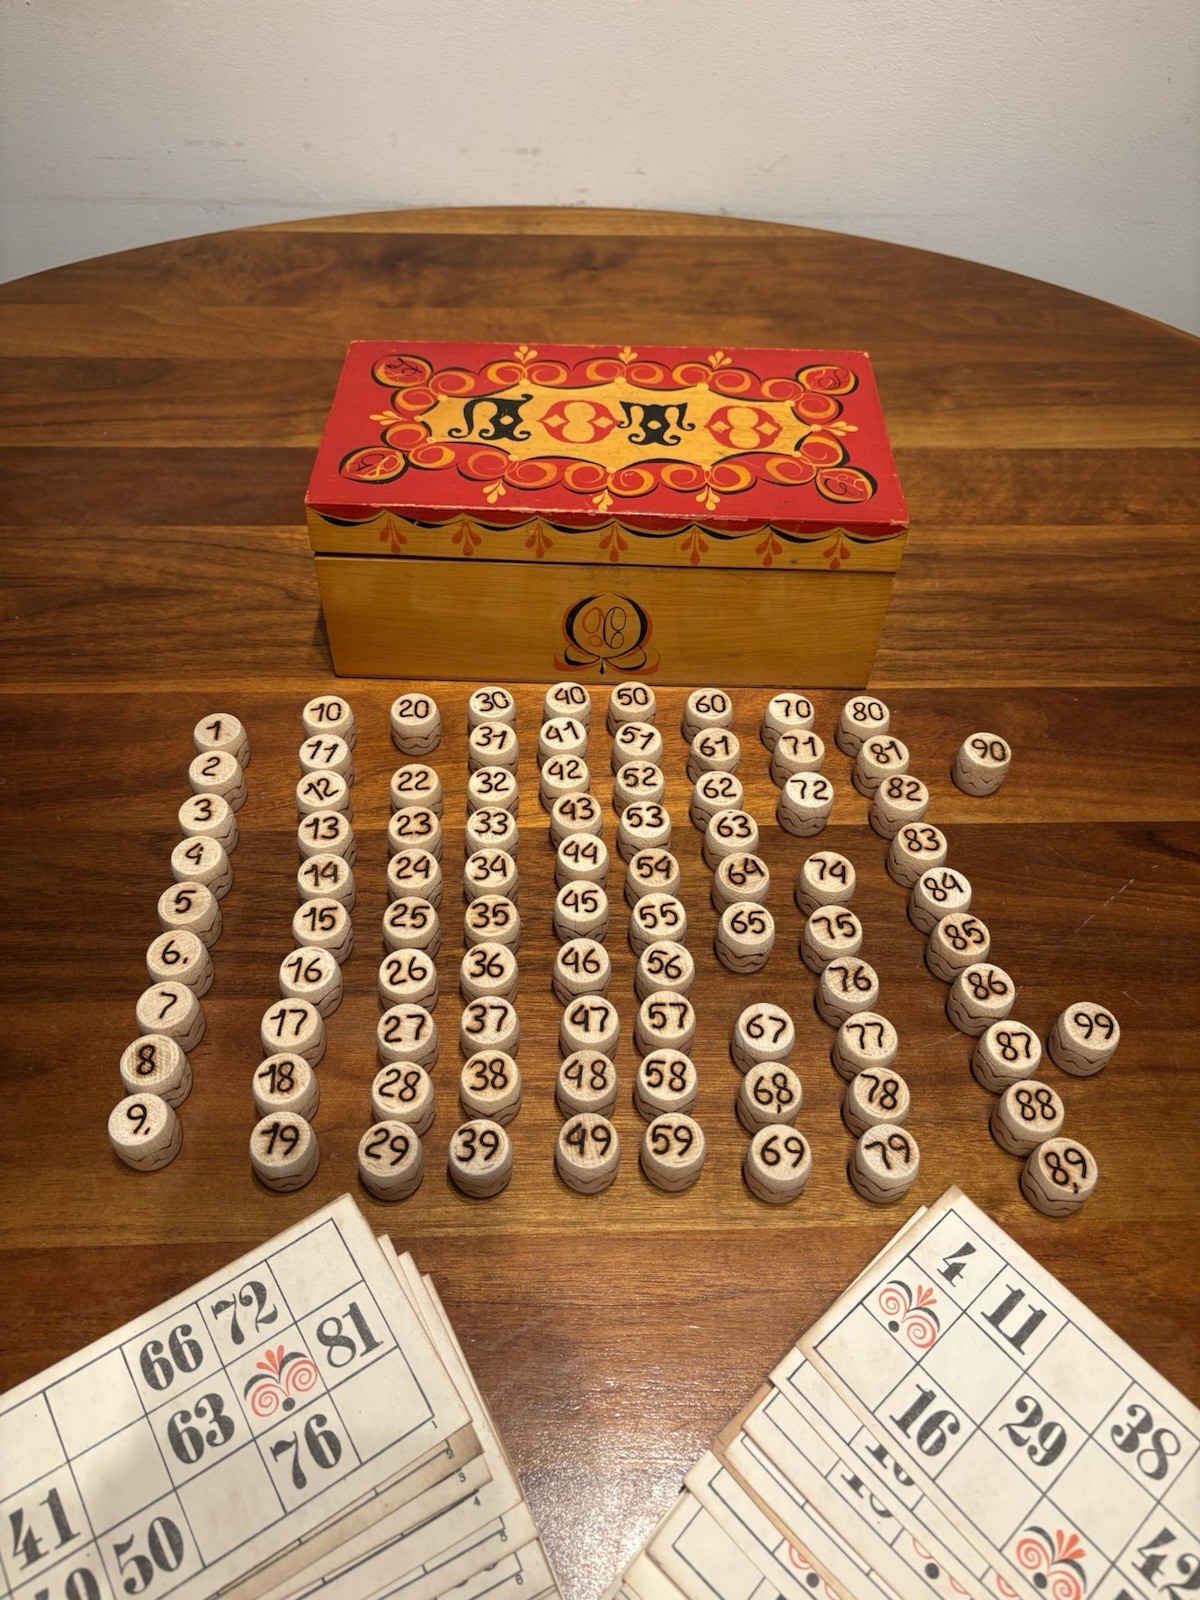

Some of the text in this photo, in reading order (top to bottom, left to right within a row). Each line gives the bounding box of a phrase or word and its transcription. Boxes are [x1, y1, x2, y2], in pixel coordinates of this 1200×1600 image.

[476, 691, 510, 712] 30
[554, 686, 586, 704] 40
[617, 687, 650, 705] 50
[696, 695, 726, 713] 60
[310, 702, 342, 722] 10
[399, 700, 429, 718] 20
[775, 700, 811, 718] 70
[853, 702, 884, 721] 80
[206, 721, 222, 740] 1
[475, 726, 508, 750] 31
[545, 721, 579, 742] 41
[620, 726, 654, 750] 51
[307, 740, 339, 763] 11
[699, 735, 729, 757] 61
[782, 736, 817, 756] 71
[870, 741, 902, 764] 81
[971, 739, 1008, 762] 90
[202, 757, 221, 776] 2
[548, 760, 582, 780] 42
[623, 767, 657, 787] 52
[303, 778, 339, 801] 12
[398, 771, 430, 791] 22
[476, 772, 509, 793] 32
[703, 777, 737, 798] 62
[790, 780, 829, 801] 72
[887, 777, 921, 801] 82
[194, 798, 213, 821] 3
[559, 797, 594, 821] 43
[627, 806, 664, 828] 53
[305, 816, 339, 840] 13
[397, 812, 432, 836] 23
[475, 811, 508, 835] 33
[716, 815, 752, 838] 63
[563, 841, 597, 864] 44
[904, 828, 940, 852] 83
[185, 843, 204, 865] 4
[304, 861, 339, 887] 14
[396, 856, 430, 880] 24
[471, 855, 507, 881] 34
[637, 856, 672, 880] 54
[727, 858, 765, 887] 64
[809, 858, 847, 885] 74
[923, 872, 964, 902] 84
[173, 889, 197, 914] 5
[562, 890, 598, 913] 45
[303, 906, 338, 931] 15
[390, 903, 431, 930] 25
[472, 902, 509, 928] 35
[639, 902, 679, 929] 55
[731, 911, 766, 934] 65
[812, 913, 857, 939] 75
[944, 919, 985, 951] 85
[287, 957, 322, 983] 16
[386, 956, 427, 986] 26
[469, 949, 504, 979] 36
[561, 947, 600, 974] 46
[647, 950, 682, 980] 56
[828, 965, 872, 992] 76
[966, 970, 1008, 1001] 86
[158, 992, 180, 1020] 7
[466, 1004, 508, 1034] 37
[570, 1004, 609, 1032] 47
[648, 1002, 688, 1030] 57
[270, 1009, 308, 1037] 17
[384, 1014, 426, 1043] 27
[746, 1014, 787, 1043] 67
[846, 1022, 884, 1050] 77
[996, 1031, 1031, 1061] 87
[136, 1043, 157, 1077] 8
[258, 1061, 297, 1095] 18
[379, 1069, 421, 1102] 28
[470, 1058, 508, 1091] 38
[564, 1059, 608, 1091] 48
[645, 1060, 686, 1092] 58
[860, 1073, 899, 1111] 78
[1014, 1089, 1057, 1121] 88
[261, 1122, 300, 1156] 19
[365, 1128, 410, 1166] 29
[456, 1127, 499, 1163] 39
[564, 1122, 611, 1157] 49
[651, 1124, 694, 1157] 59
[760, 1135, 805, 1168] 69
[864, 1133, 911, 1170] 79
[937, 1242, 978, 1288] 4
[212, 1280, 279, 1345] 72
[981, 1283, 1048, 1356] 11
[316, 1302, 384, 1368] 81
[139, 1323, 204, 1391] 66
[167, 1393, 235, 1464] 63
[889, 1383, 961, 1457] 16
[998, 1394, 1068, 1467] 29
[269, 1413, 342, 1490] 76
[1110, 1403, 1182, 1480] 38
[457, 1472, 467, 1483] 3
[473, 1496, 481, 1507] 4
[8, 1487, 81, 1570] 41
[113, 1516, 184, 1595] 50
